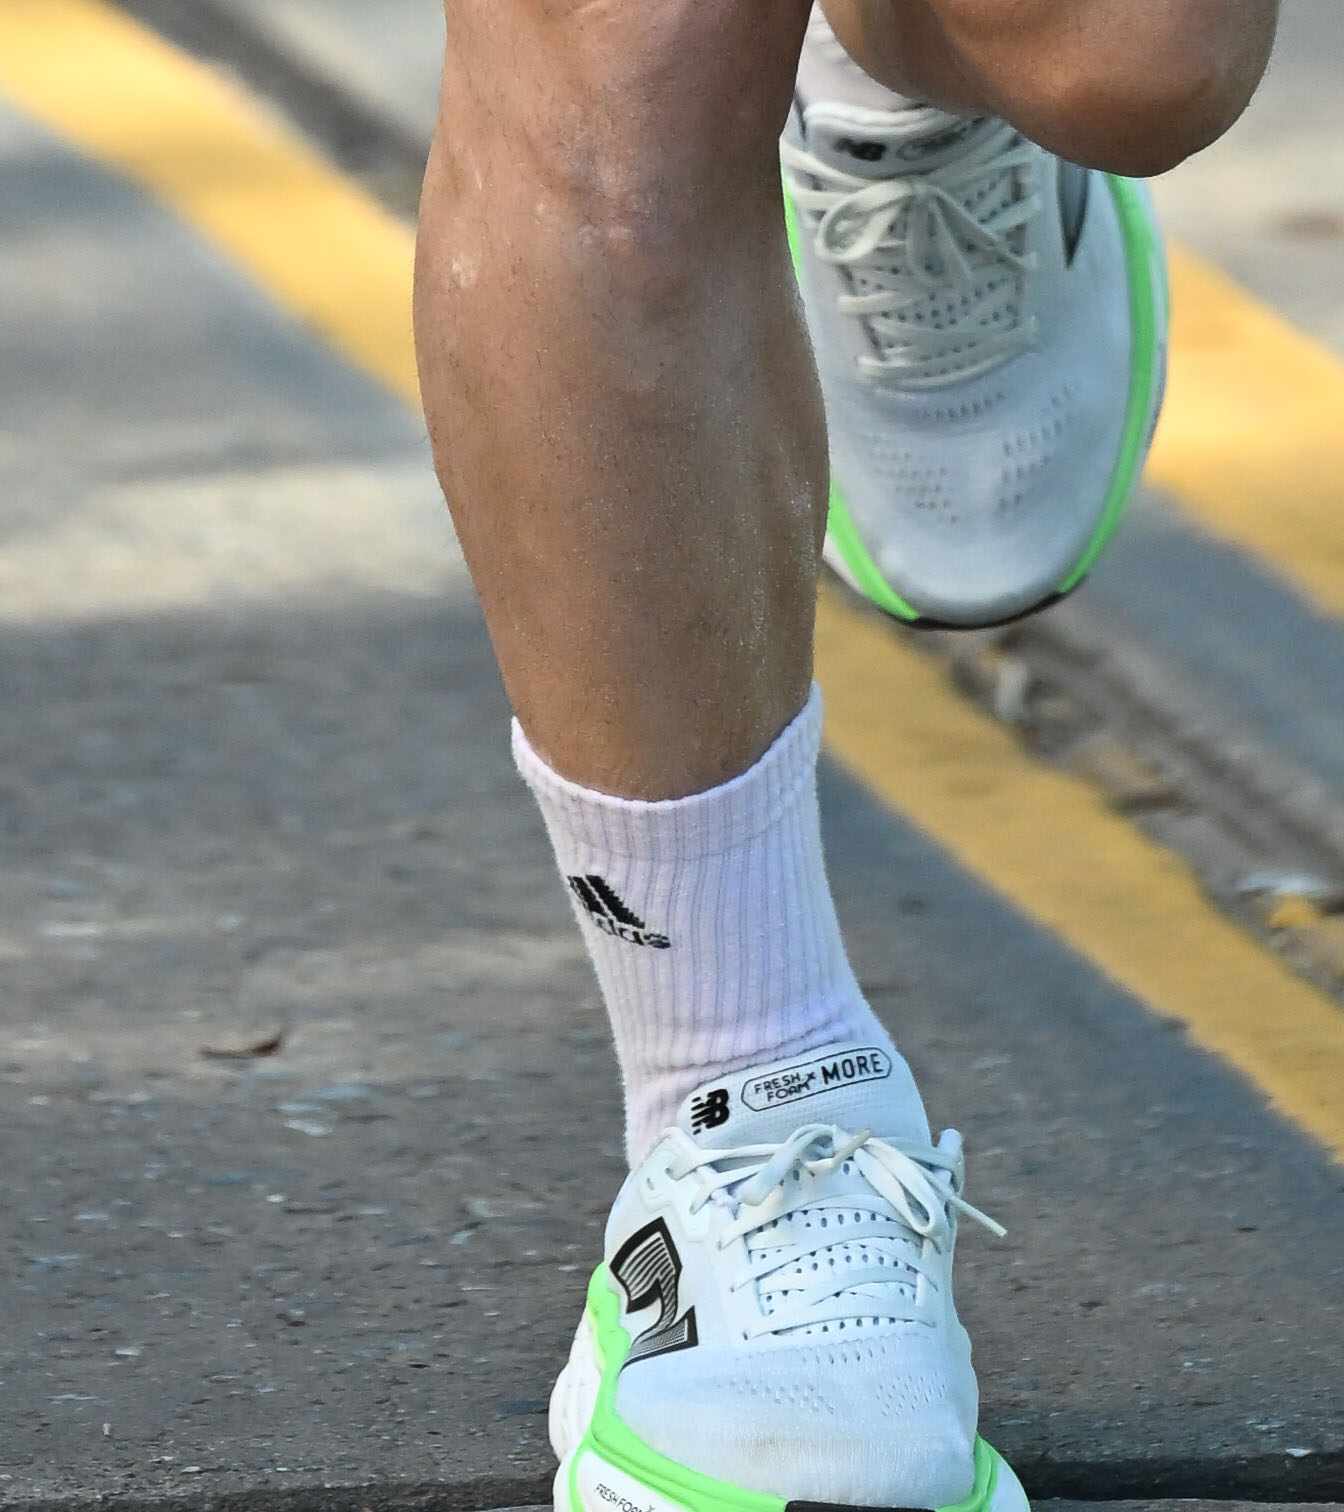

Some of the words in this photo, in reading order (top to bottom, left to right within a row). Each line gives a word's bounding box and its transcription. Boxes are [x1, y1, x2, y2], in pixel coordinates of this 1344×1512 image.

[821, 1052, 885, 1085] MORE
[754, 1072, 801, 1095] FRESH
[766, 1081, 810, 1102] FOAM
